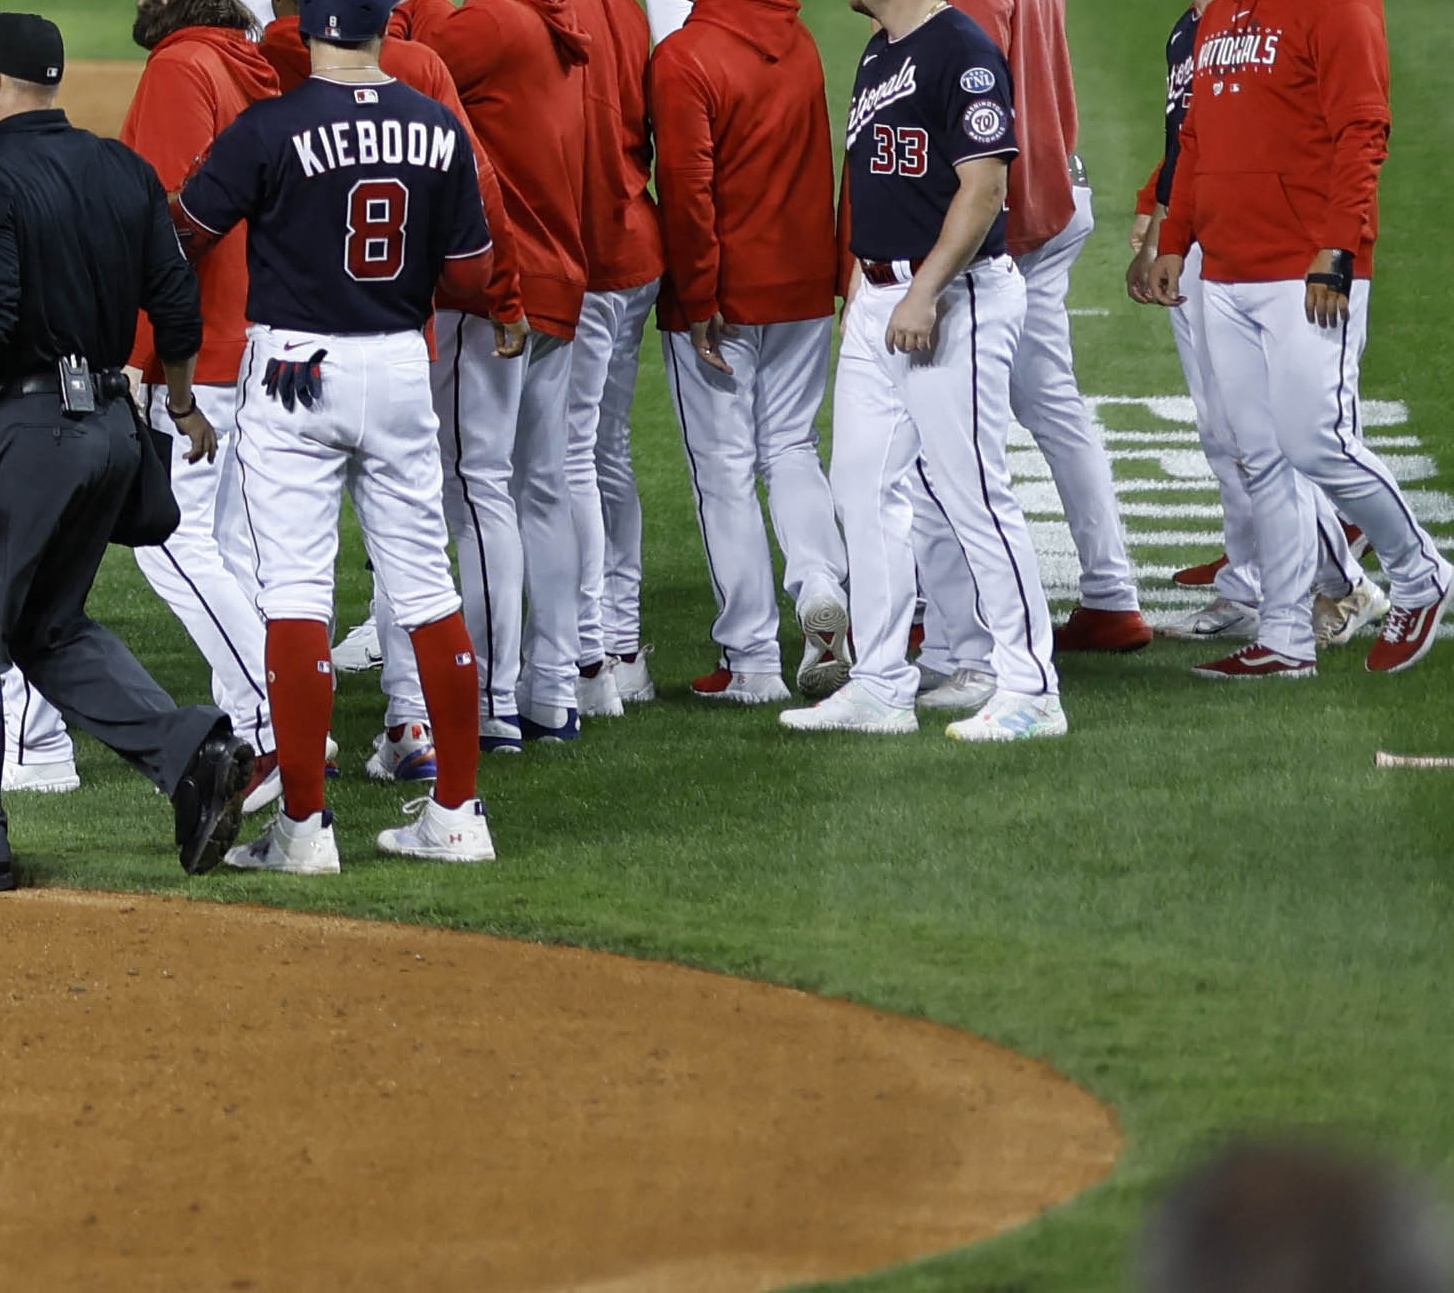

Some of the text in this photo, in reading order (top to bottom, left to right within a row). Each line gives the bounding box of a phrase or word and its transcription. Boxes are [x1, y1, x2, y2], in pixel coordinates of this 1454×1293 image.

[1197, 33, 1279, 72] NATIONALS
[962, 75, 994, 89] TNL
[292, 119, 456, 178] KIEBOOM
[870, 123, 929, 178] 33
[344, 178, 410, 282] 8
